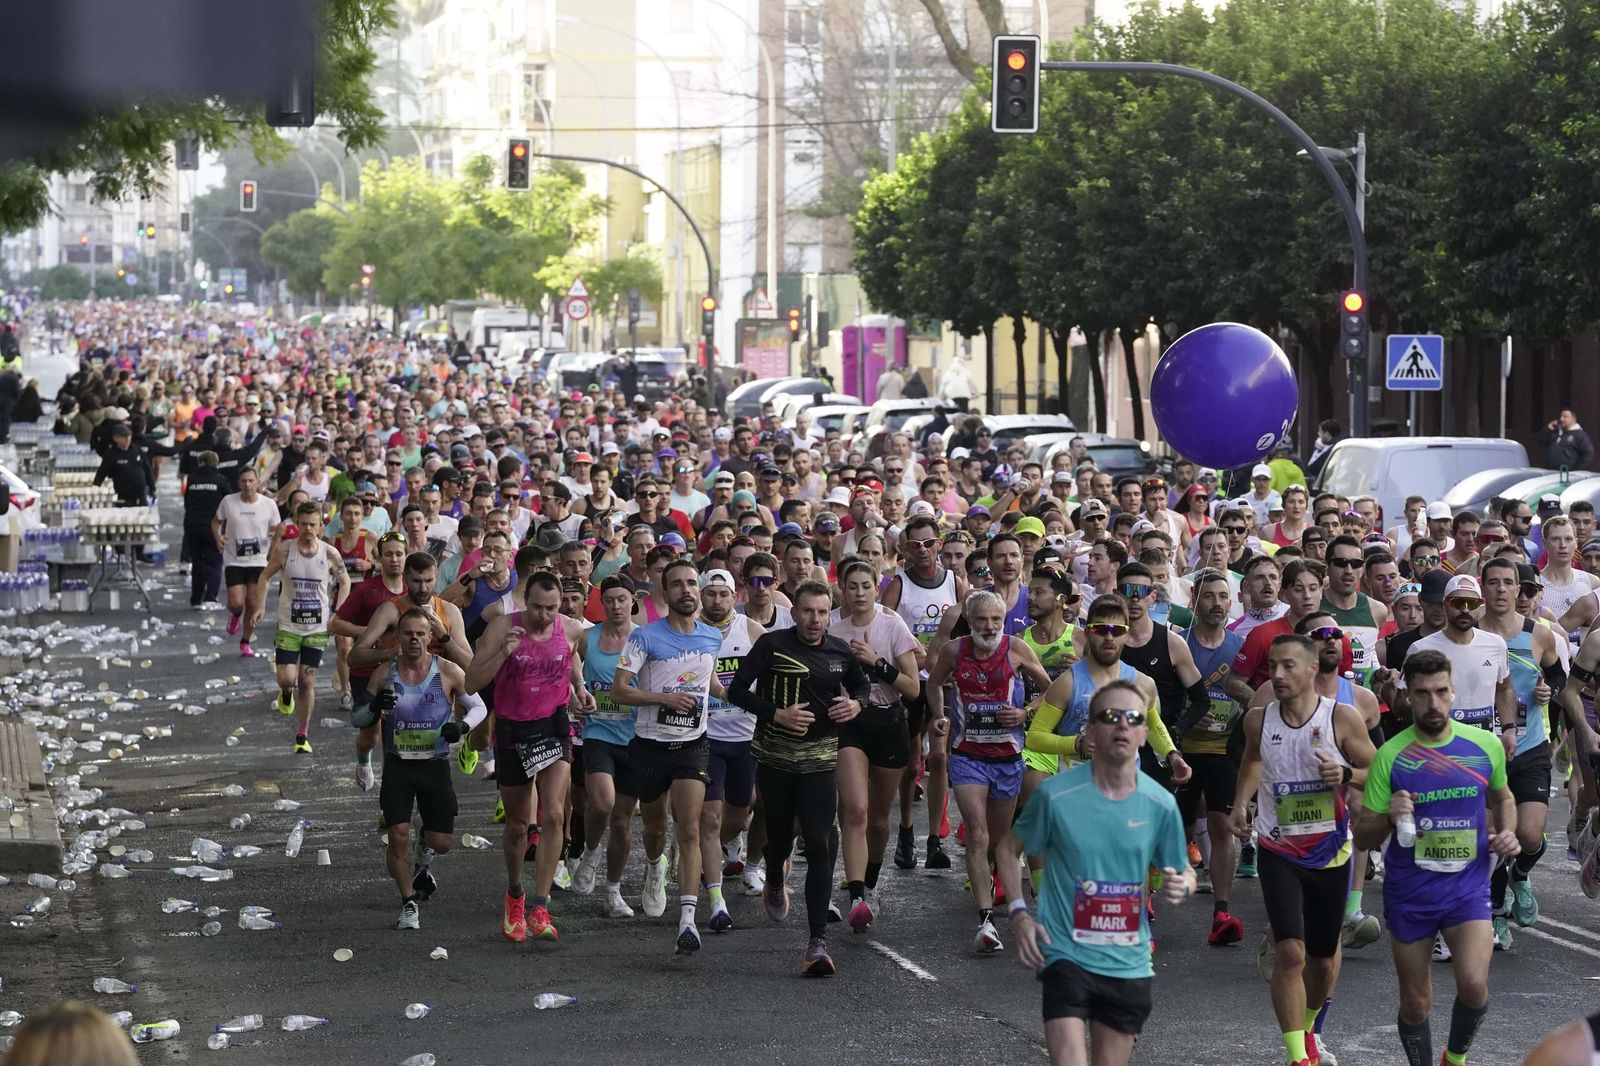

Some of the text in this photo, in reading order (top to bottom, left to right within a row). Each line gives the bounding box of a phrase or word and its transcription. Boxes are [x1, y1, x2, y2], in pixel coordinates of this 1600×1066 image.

[1208, 691, 1228, 699] URICH
[665, 714, 695, 727] MANUÉ
[1293, 782, 1327, 792] ZURICH
[1295, 799, 1314, 808] 3150
[1289, 809, 1322, 823] JUANI
[1436, 820, 1470, 828] ZURICH
[1438, 836, 1456, 845] 3070
[1423, 847, 1470, 859] ANDRES
[1091, 915, 1128, 930] MARK
